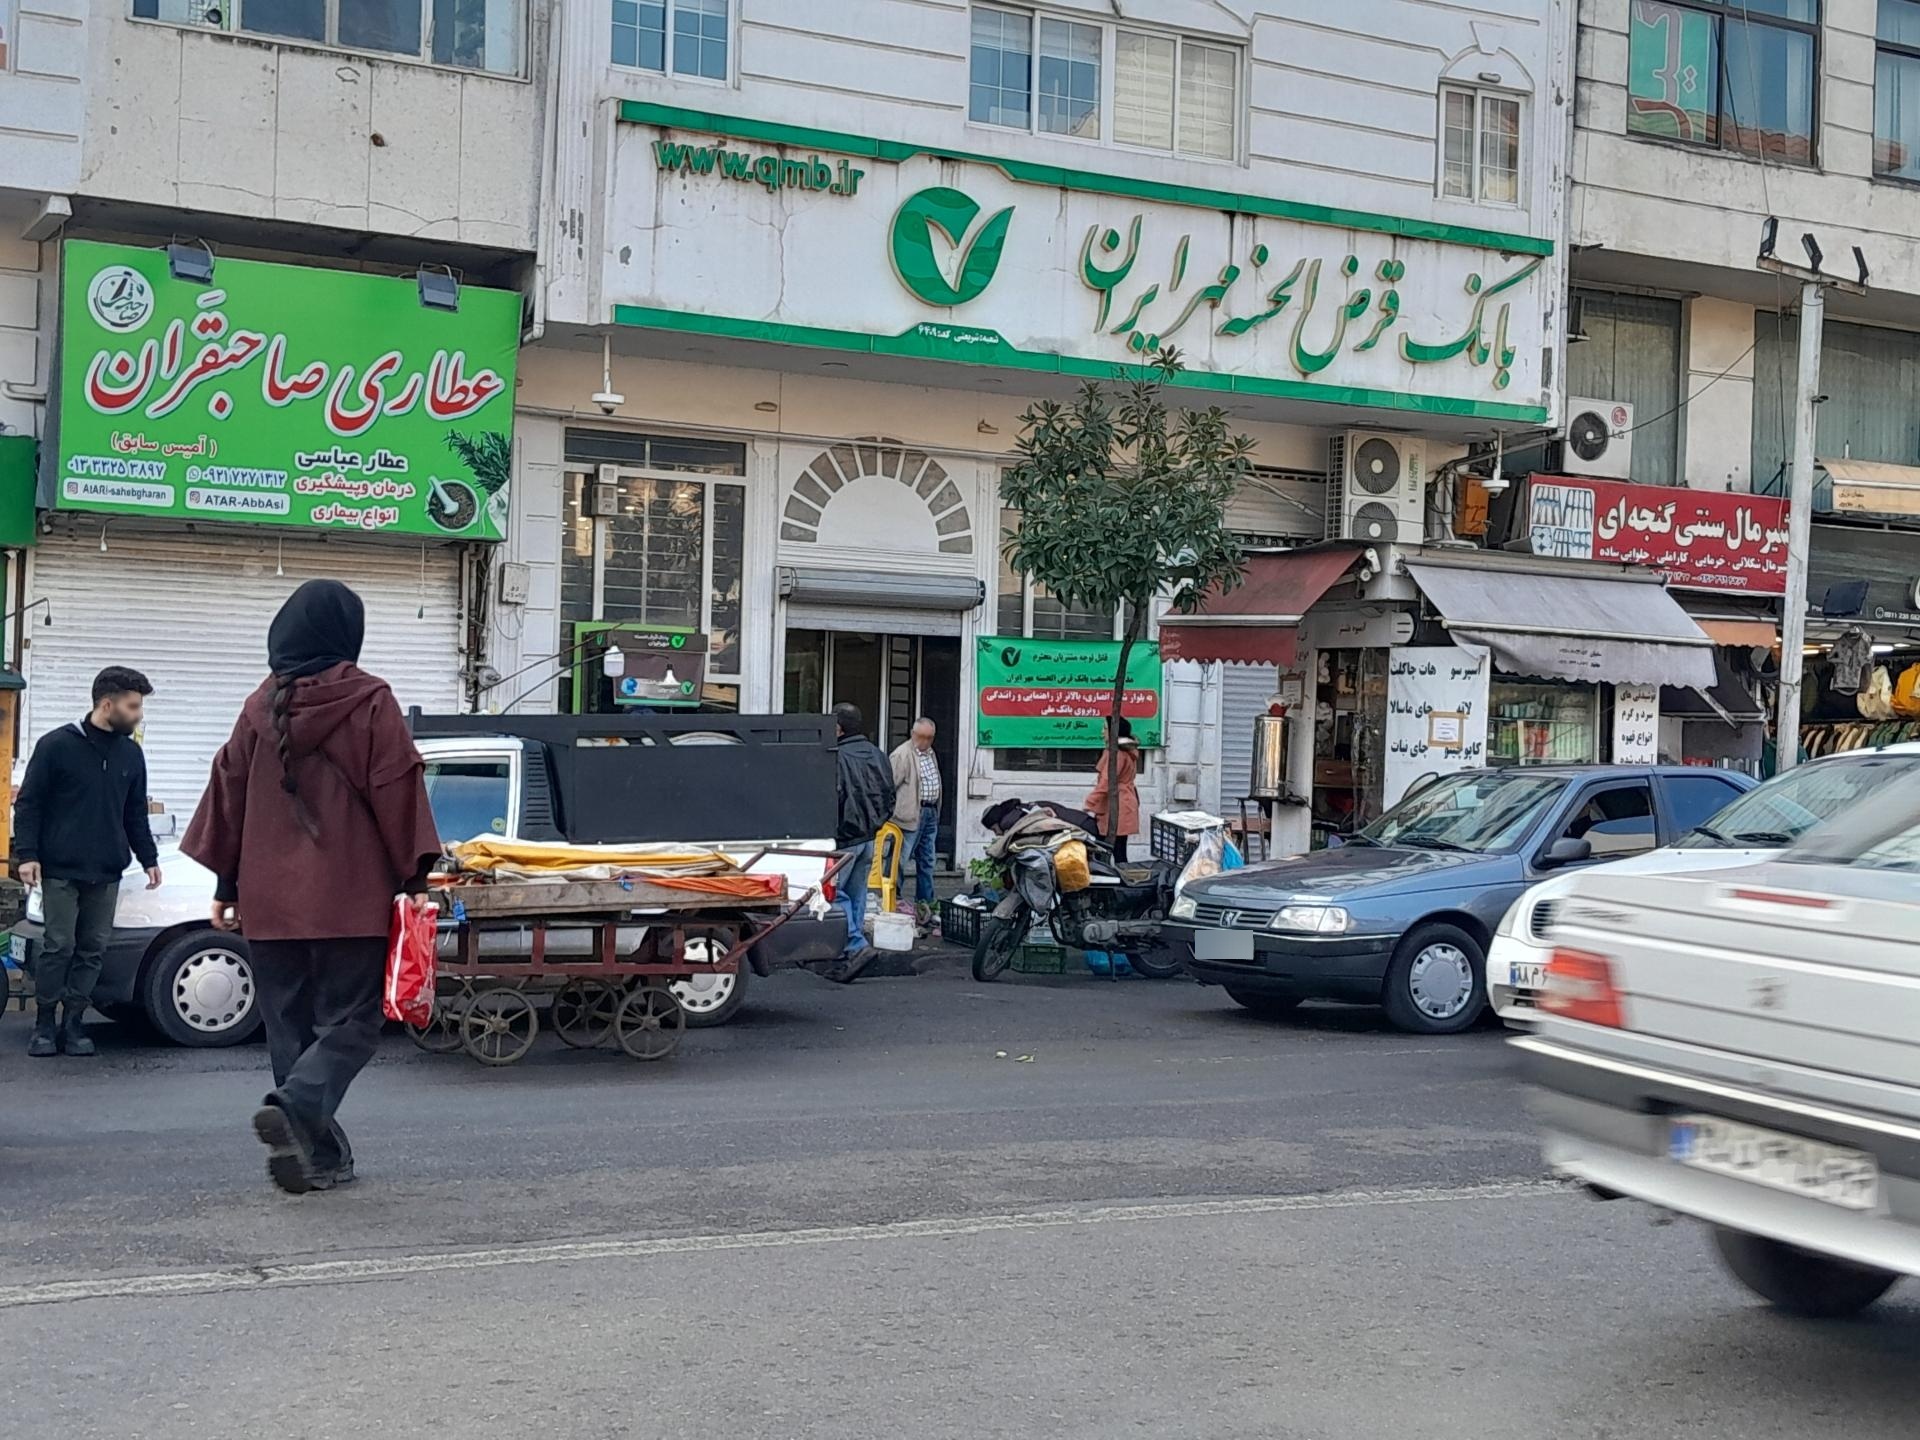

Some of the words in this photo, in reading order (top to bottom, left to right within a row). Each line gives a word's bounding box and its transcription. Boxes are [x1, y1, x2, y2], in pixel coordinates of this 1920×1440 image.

[652, 140, 866, 195] www.qmb.ir
[1400, 259, 1544, 390] بانک
[327, 353, 502, 433] عطاری
[297, 447, 360, 471] عباسی
[365, 449, 407, 471] عطار
[313, 505, 359, 524] بیماری
[362, 508, 397, 527] انواع
[1674, 509, 1726, 547] سنتی
[1599, 546, 1620, 559] ساده
[1390, 661, 1417, 680] چاکلت
[1419, 661, 1437, 676] هات
[986, 690, 1016, 703] رانندگی
[1022, 690, 1054, 703] راهنمایی
[1056, 704, 1073, 716] بانک
[1074, 706, 1100, 717] روبروی
[1390, 699, 1414, 714] ماسالا
[1621, 708, 1634, 721] گرم
[1640, 710, 1654, 722] سرد
[1390, 738, 1409, 757] نبات
[1636, 731, 1653, 746] انواع
[1410, 739, 1429, 758] چای
